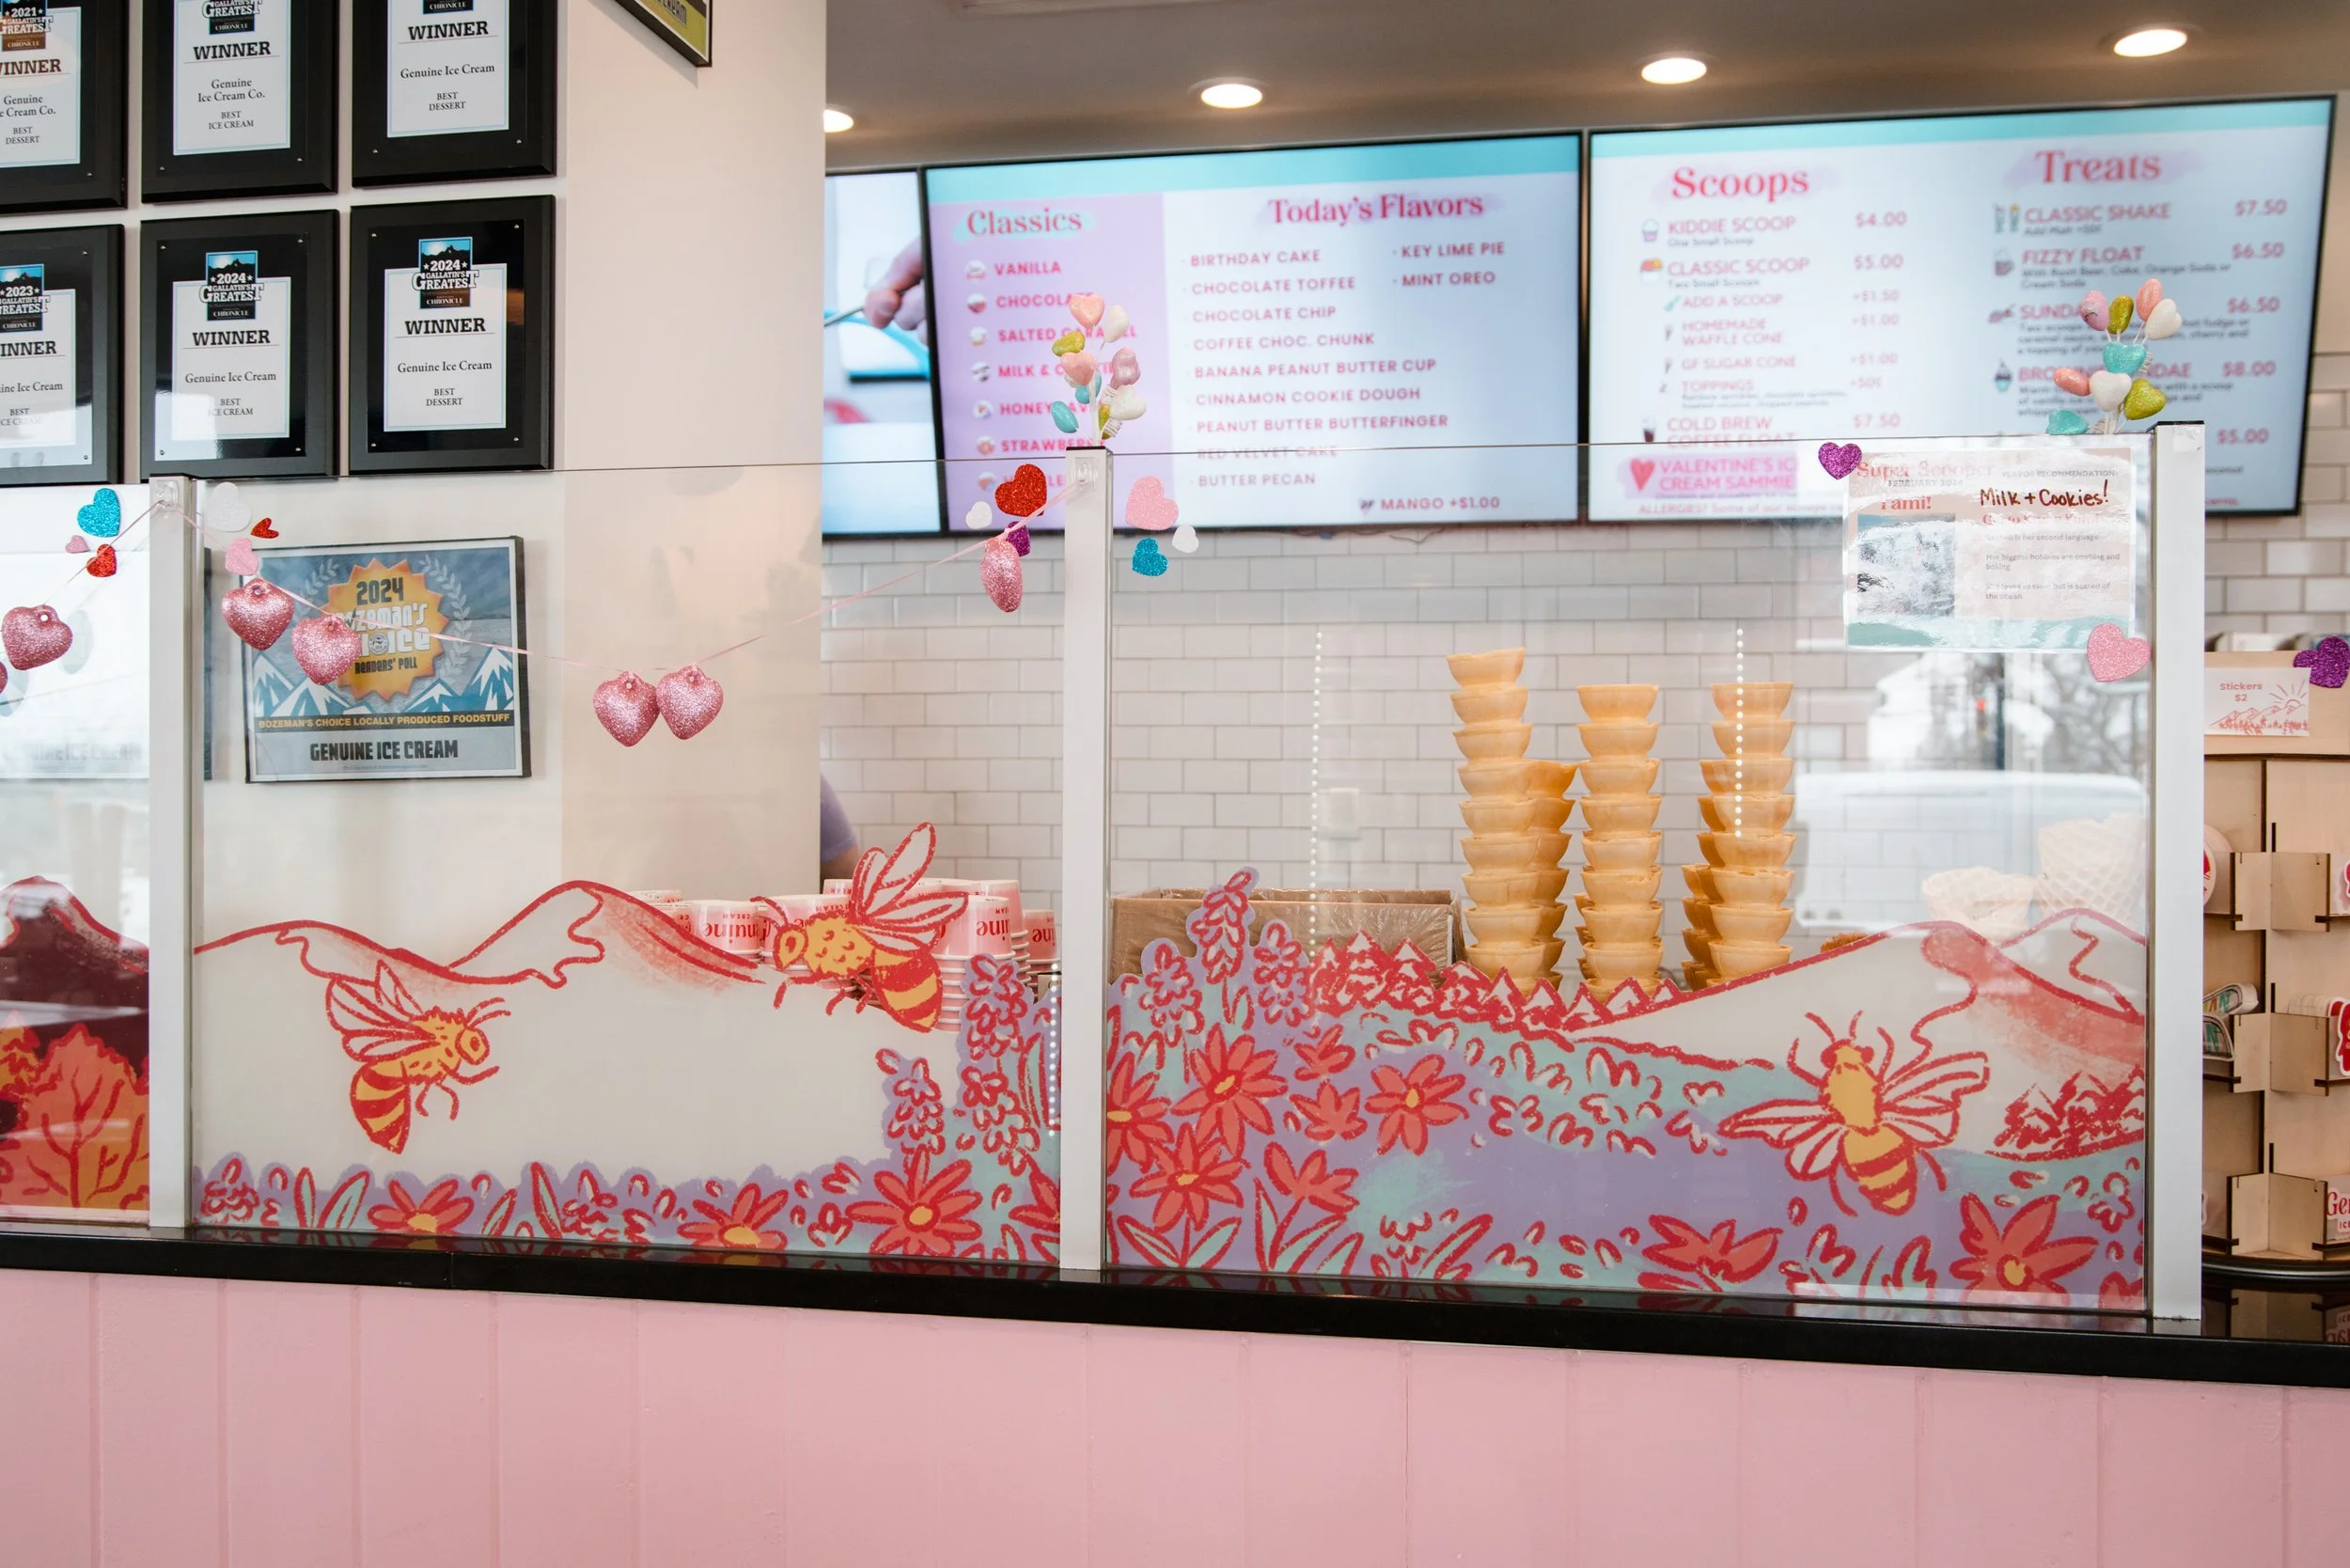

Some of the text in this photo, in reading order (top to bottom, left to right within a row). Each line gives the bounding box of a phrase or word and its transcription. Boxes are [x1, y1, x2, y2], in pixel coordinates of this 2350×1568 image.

[11, 7, 38, 18] 2021
[202, 0, 261, 18] GREATEST
[408, 21, 489, 41] WINNER
[193, 41, 272, 60] WINNER
[0, 58, 62, 76] INNER
[400, 64, 495, 79] Genuine Ice Cream
[211, 78, 253, 89] Genuine
[4, 94, 43, 105] Genuine
[197, 89, 266, 102] Ice Cream Co.
[436, 92, 459, 101] BEST
[7, 106, 38, 118] Cream
[39, 105, 56, 116] Co.
[221, 110, 242, 118] BEST
[429, 101, 466, 111] DESSERT
[13, 126, 33, 134] BEST
[209, 118, 255, 130] ICE CREAM
[6, 135, 40, 145] DESSERT
[2035, 148, 2163, 185] Treats
[1670, 165, 1810, 203] Scoops
[1270, 194, 1484, 227] Today's Flavors
[2024, 202, 2171, 225] CLASSIC SHAKE
[2233, 198, 2288, 217] $7.50
[966, 206, 1083, 235] Classics
[1668, 215, 1796, 235] KIDDIE SCOOP
[1854, 211, 1907, 228] $4.00
[1402, 241, 1506, 259] KEY LIME PIE
[2021, 245, 2145, 265] FIZZY FLOAT
[2231, 242, 2285, 259] $6.50
[430, 259, 462, 272] 2024
[1190, 249, 1321, 268] BIRTHDAY CAKE
[1853, 253, 1904, 270] $5.00
[994, 260, 1062, 276] VANILLA
[1667, 257, 1810, 277] CLASSIC SCOOP
[216, 273, 246, 285] 2024
[412, 270, 479, 290] GREATEST
[1191, 275, 1355, 295] CHOCOLATE TOFFEE
[1402, 271, 1496, 287] MINT OREO
[6, 285, 34, 297] 2023
[199, 283, 264, 304] GREATEST
[1683, 292, 1783, 308] ADD A SCOOP
[2226, 296, 2280, 314] $6.50
[1192, 306, 1337, 322] CHOCOLATE CHIP
[404, 318, 486, 335] WINNER
[1682, 317, 1767, 332] HOMEMADE
[192, 330, 271, 346] WINNER
[998, 328, 1057, 342] SALTED
[1193, 332, 1374, 352] COFFEE CHOC. CHUNK
[1681, 331, 1783, 347] WAFFLE CONE
[0, 340, 57, 356] INNER
[398, 359, 493, 373] Genuine Ice Cream
[1194, 358, 1437, 379] BANANA PEANUT BUTTER CUP
[1703, 355, 1754, 369] SUGAR
[1759, 354, 1797, 368] CONE
[2222, 361, 2277, 378] $8.00
[185, 369, 276, 384] Genuine Ice Cream
[997, 365, 1035, 378] MILK
[1041, 363, 1049, 377] &
[17, 383, 30, 392] Ice
[33, 381, 63, 392] Cream
[433, 387, 456, 396] BEST
[1681, 379, 1756, 393] TOPPINGS
[220, 398, 241, 406] BEST
[426, 398, 463, 407] DESSERT
[1196, 386, 1421, 406] CINNAMON COOKIE DOUGH
[9, 408, 29, 416] BEST
[208, 406, 254, 416] ICE CREAM
[1196, 414, 1449, 433] PEANUT BUTTER BUTTERFINGER
[1667, 416, 1773, 432] COLD BREW
[1853, 413, 1902, 429] $7.50
[2217, 428, 2270, 446] $5.00
[1659, 457, 1774, 474] VALENTINE'S
[1198, 472, 1317, 488] BUTTER PECAN
[1659, 475, 1795, 492] CREAM SAMMIE
[1980, 478, 2108, 507] Milk + Cookies!
[1380, 495, 1501, 511] MANGO +$1.00
[356, 576, 405, 606] 2024
[398, 656, 418, 669] POLL
[2219, 682, 2264, 691] Stickers
[2234, 693, 2248, 702] $2
[258, 712, 510, 729] BOZEMAN'S CHOICE LOCALLY PRODUCED FOODSTUFF
[309, 739, 459, 761] GENUINE ICE CREAM
